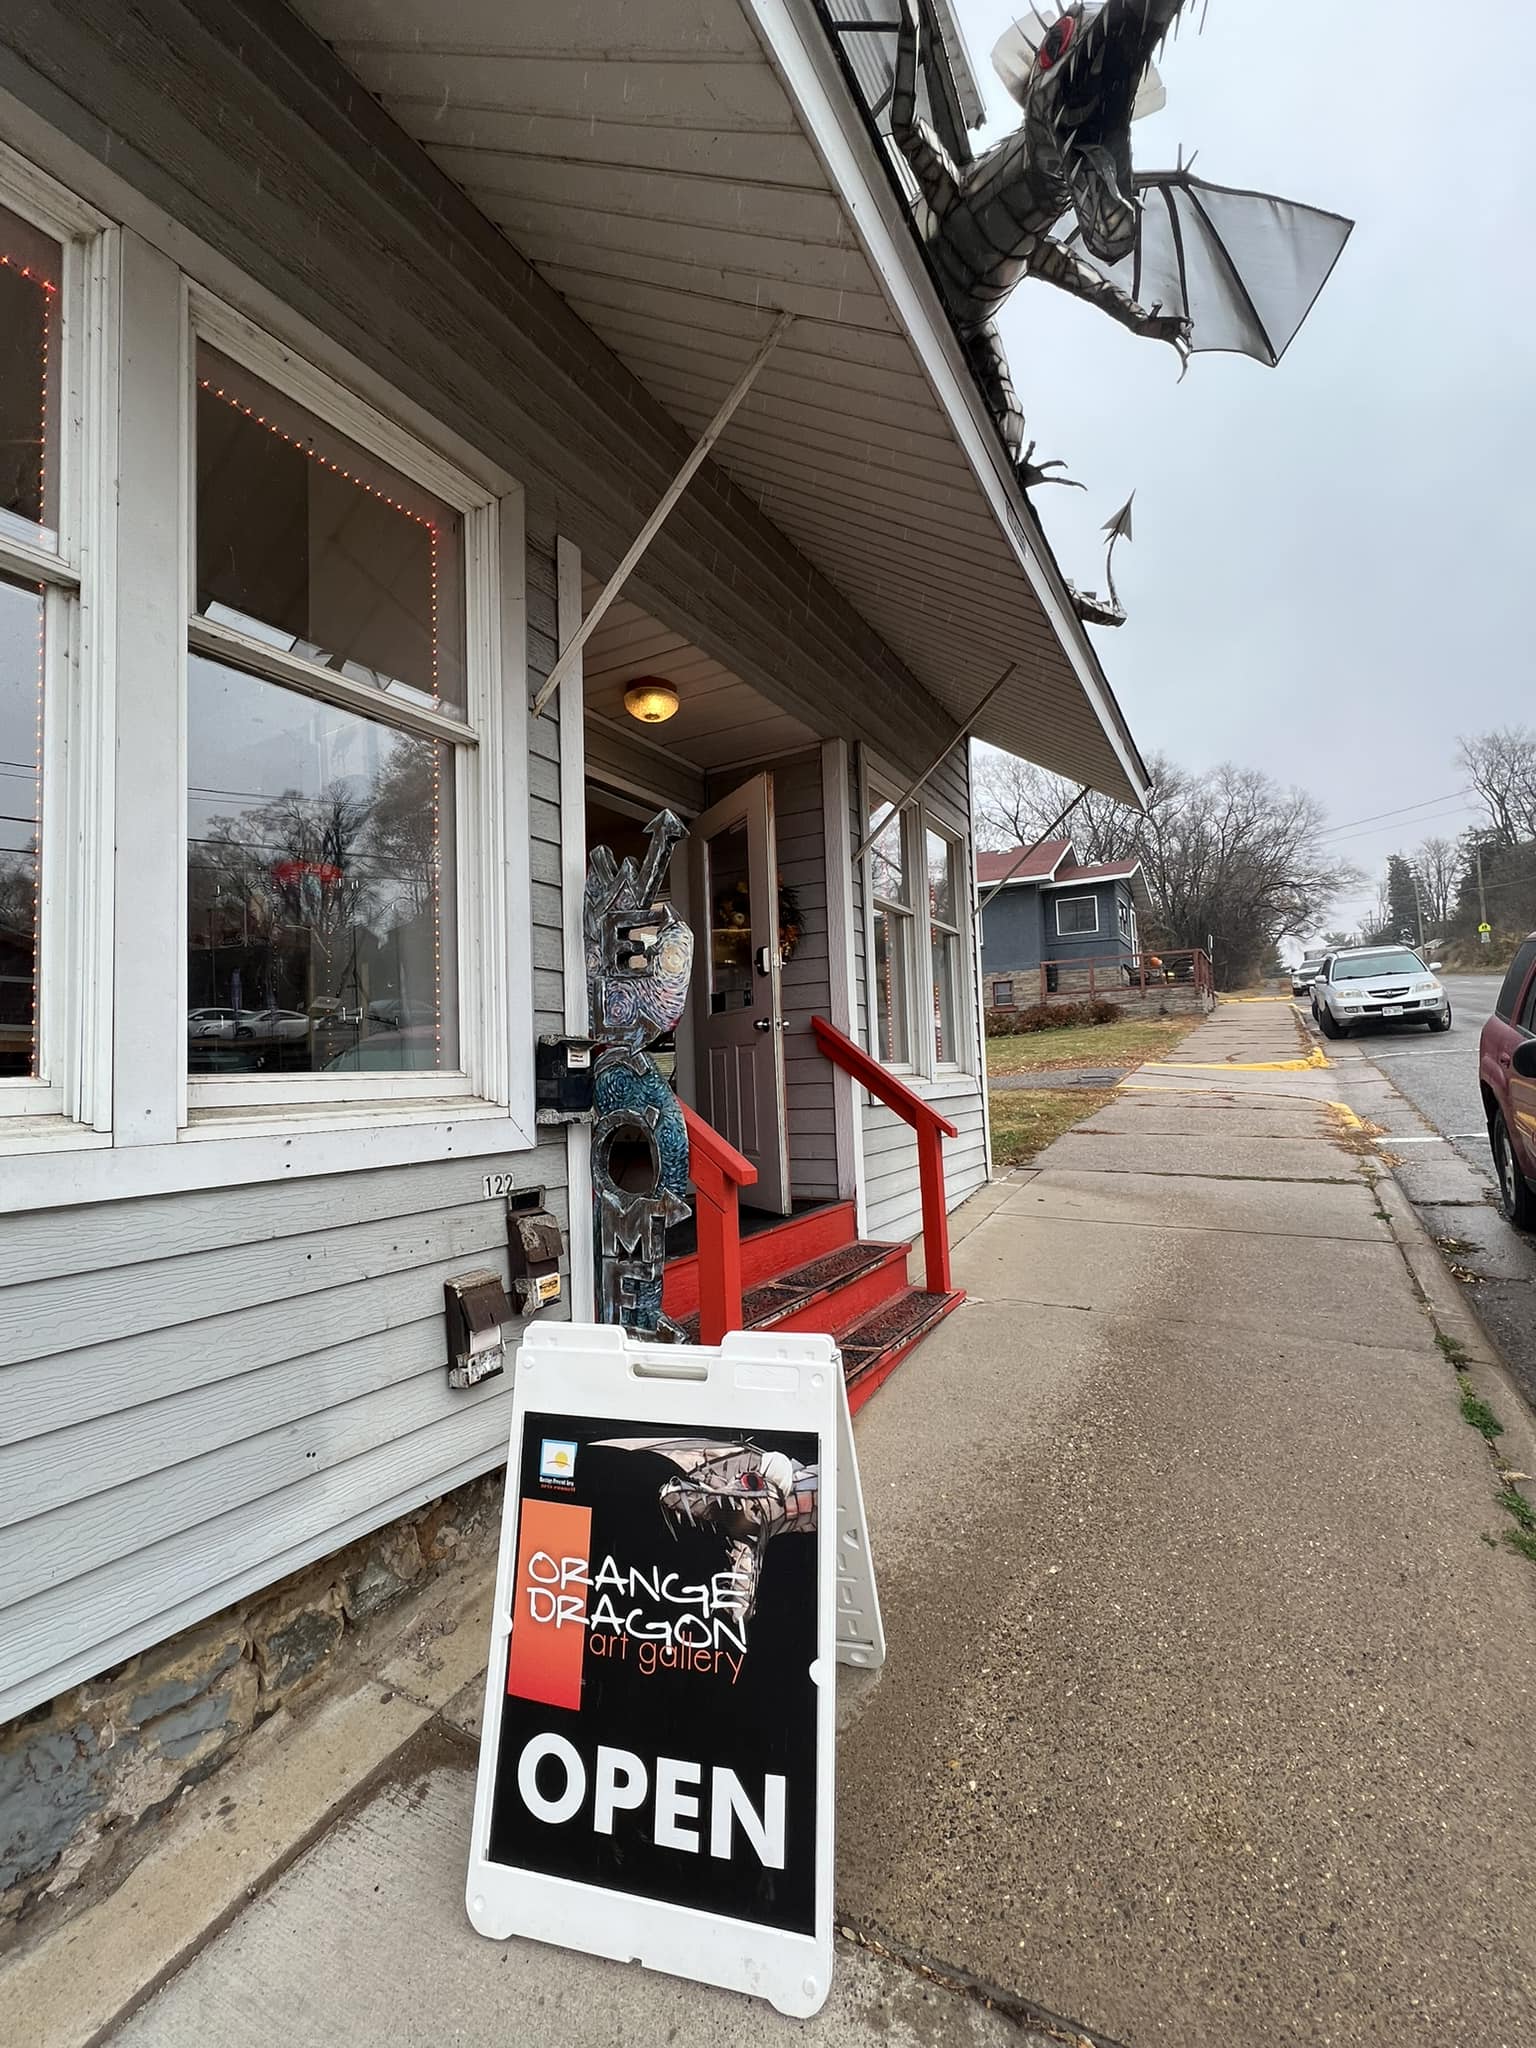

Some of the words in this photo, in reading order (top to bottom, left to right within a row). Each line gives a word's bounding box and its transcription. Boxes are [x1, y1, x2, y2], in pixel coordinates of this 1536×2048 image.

[485, 1174, 513, 1197] 122
[527, 1550, 750, 1619] ORANGE
[526, 1586, 748, 1656] DRAGON
[589, 1631, 629, 1660] art
[638, 1630, 745, 1685] gallery
[517, 1732, 786, 1870] OPEN
